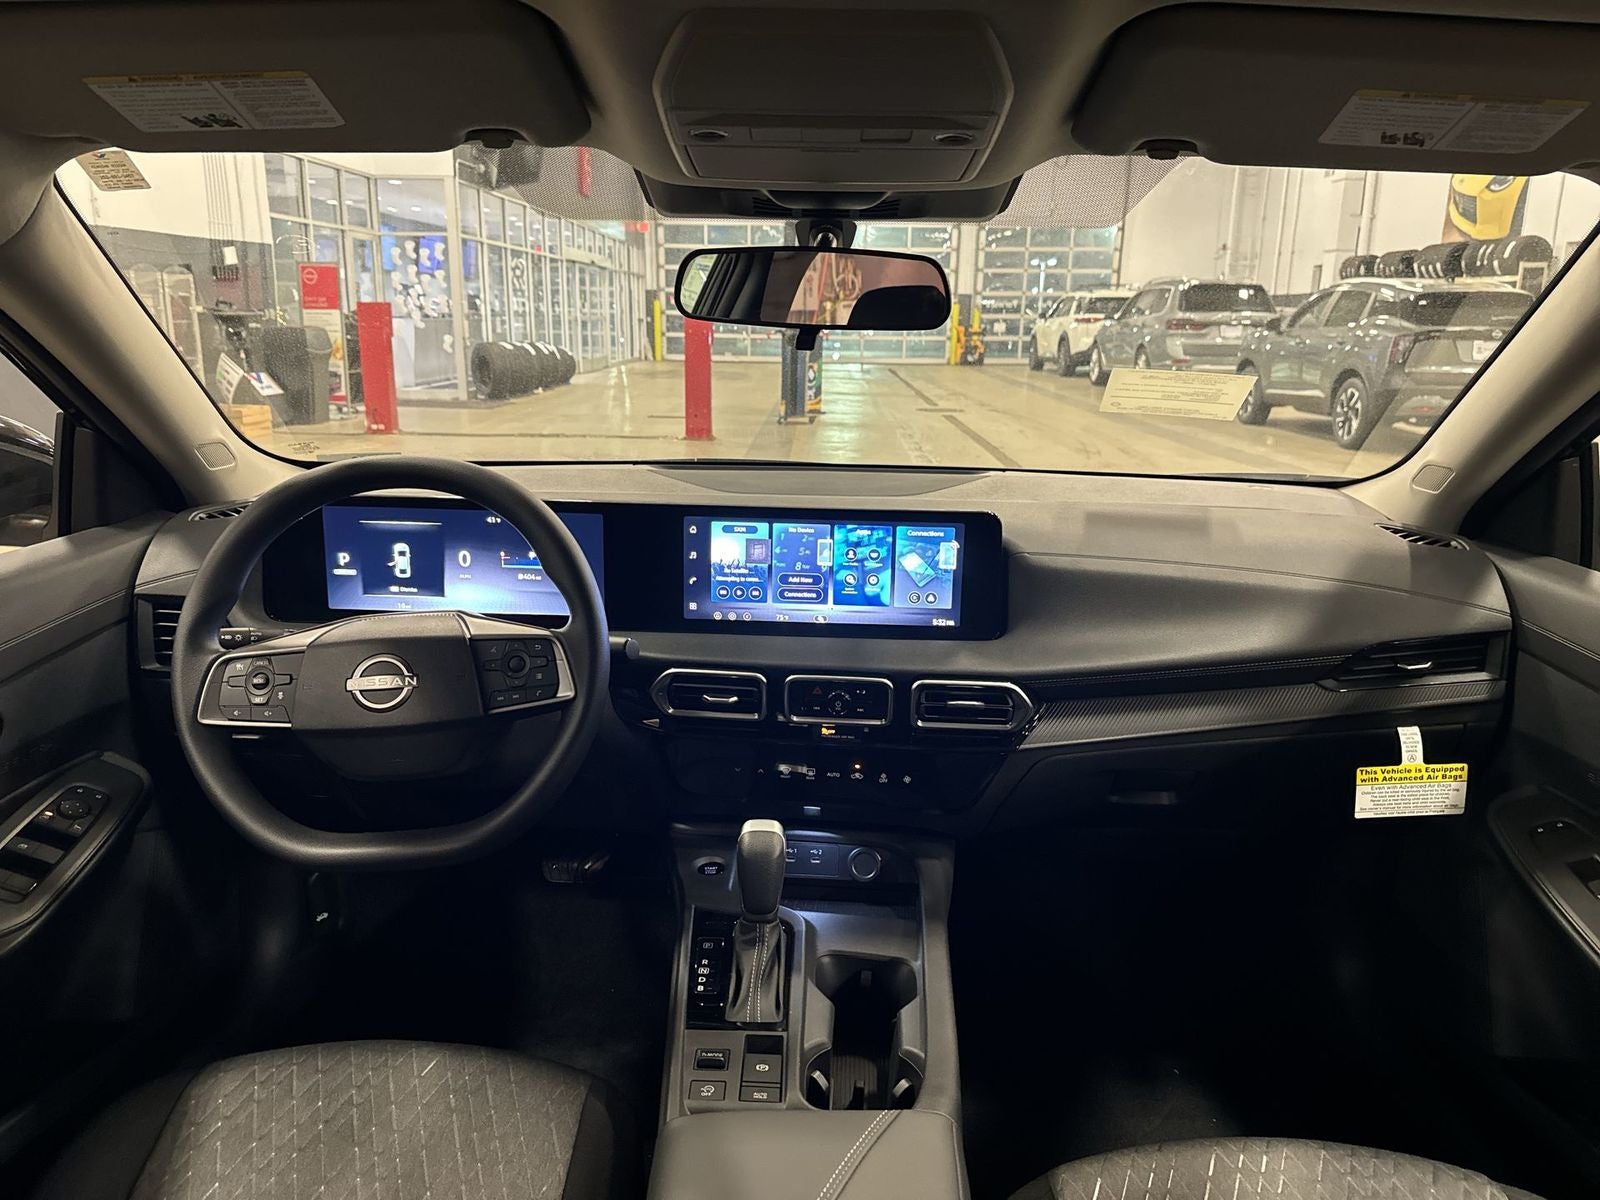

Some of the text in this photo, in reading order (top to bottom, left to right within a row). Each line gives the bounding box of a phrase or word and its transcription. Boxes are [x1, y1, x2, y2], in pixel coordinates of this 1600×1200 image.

[337, 552, 350, 566] P
[458, 550, 471, 567] 0
[348, 675, 417, 689] NISSAN
[1380, 767, 1412, 775] Vehicle
[1381, 774, 1424, 782] Advanced
